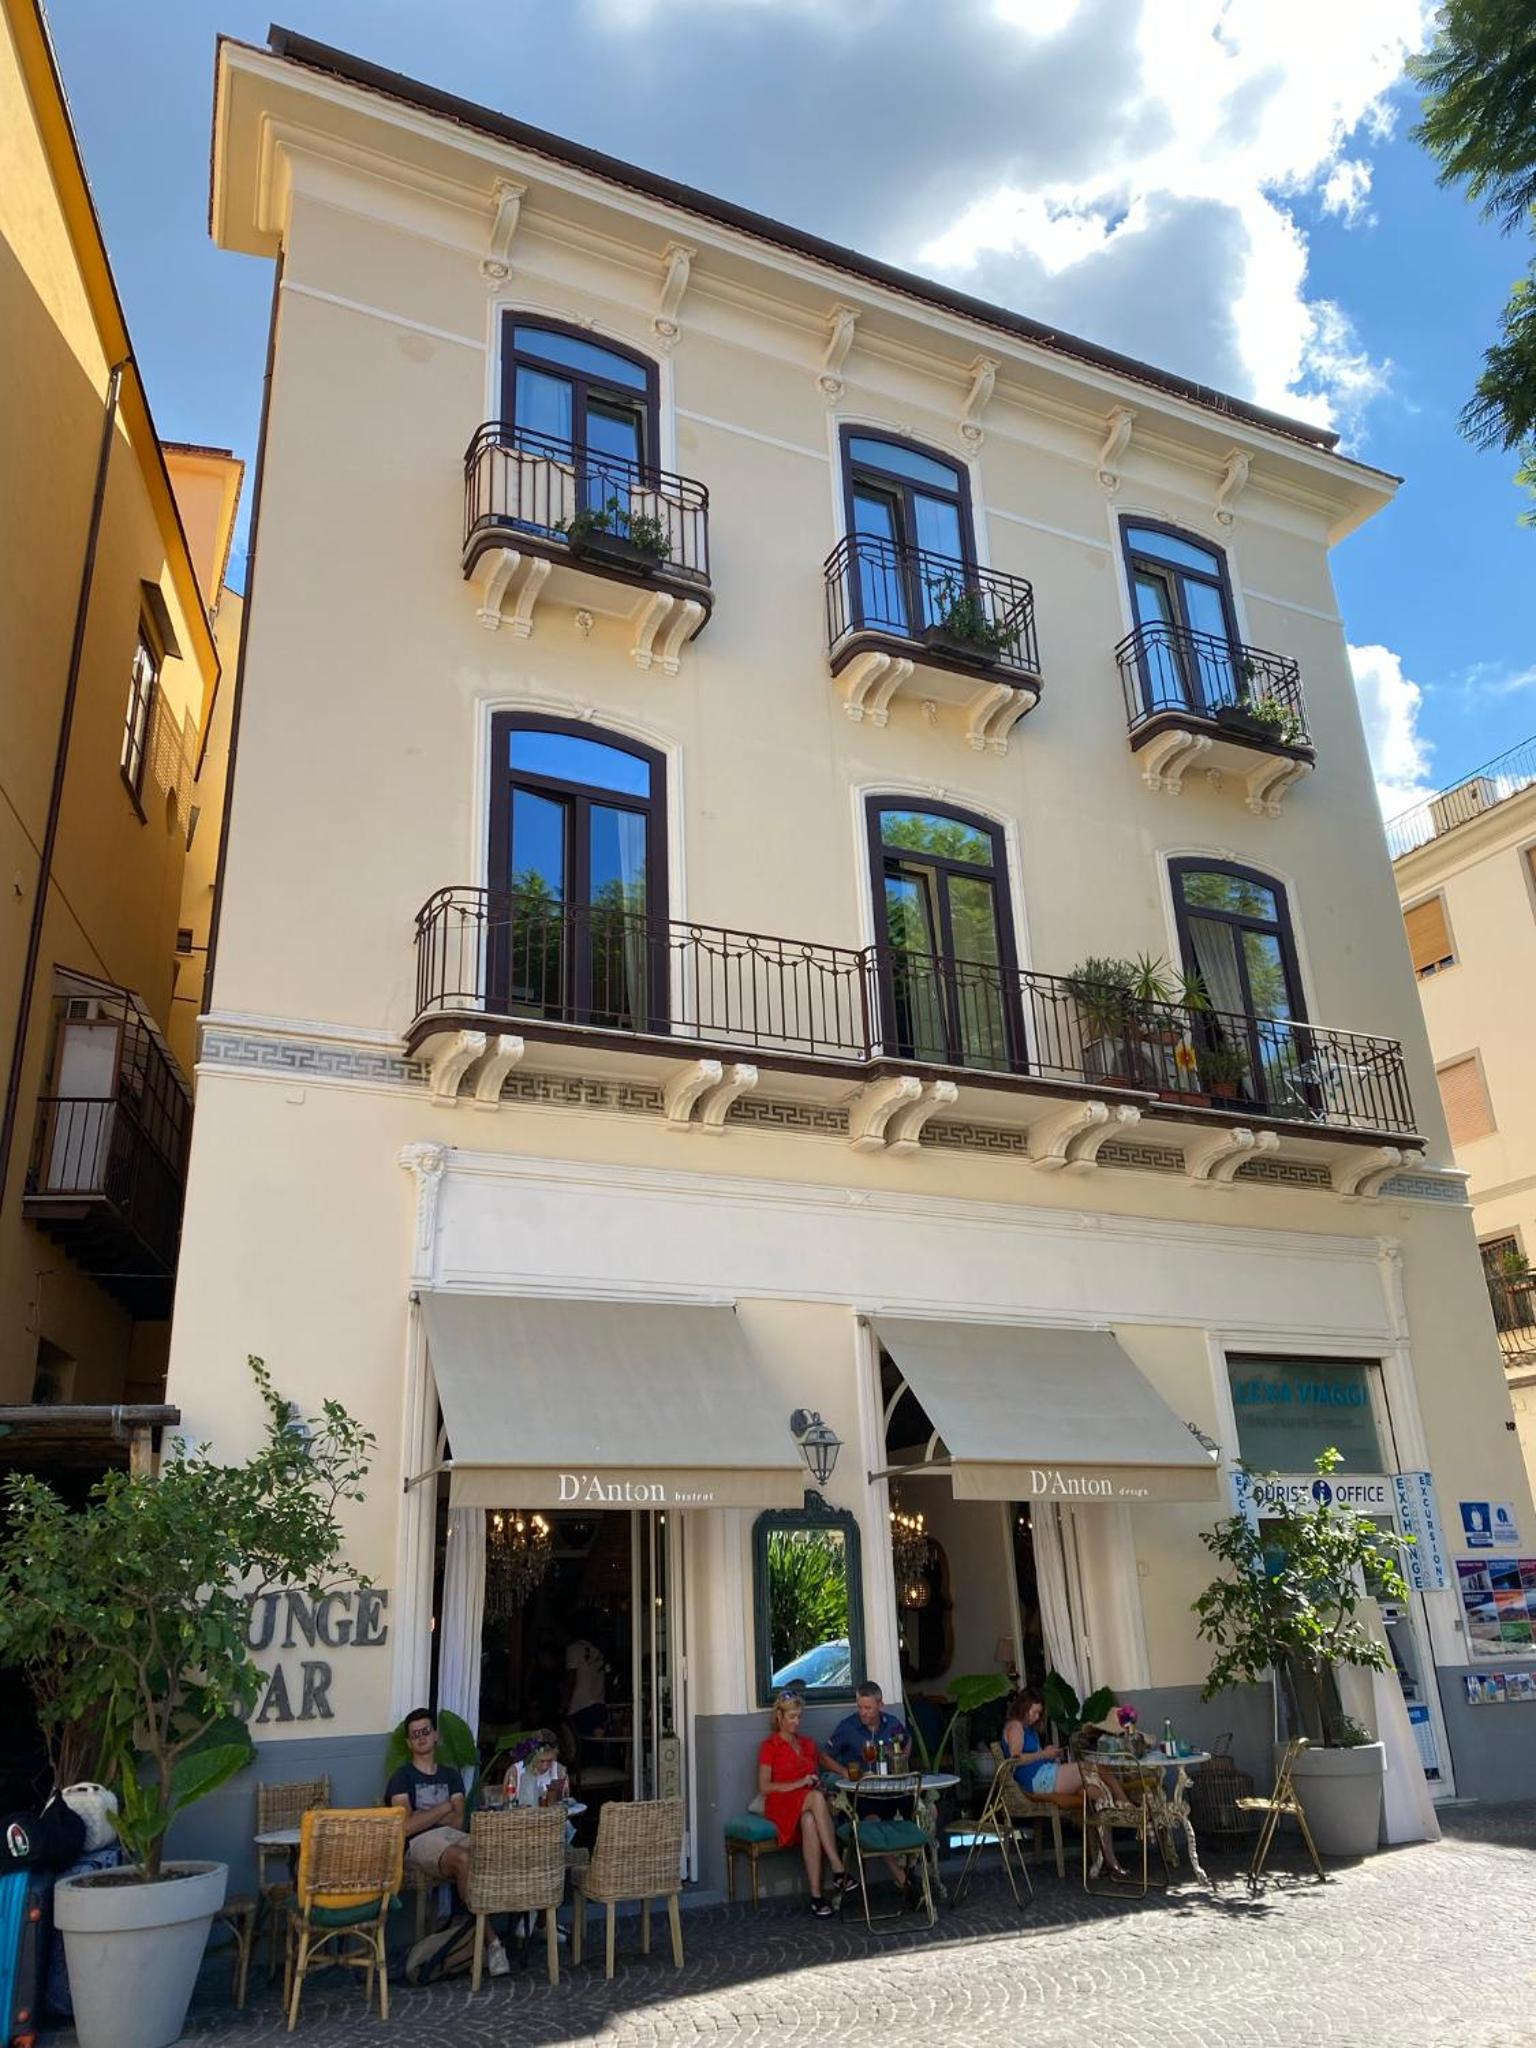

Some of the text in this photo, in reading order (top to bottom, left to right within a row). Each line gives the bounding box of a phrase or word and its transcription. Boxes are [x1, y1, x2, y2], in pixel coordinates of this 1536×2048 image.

[558, 1474, 666, 1501] D'Anton
[1030, 1470, 1113, 1495] D'Anton
[1254, 1486, 1309, 1502] OURIST
[1336, 1486, 1384, 1502] OFFICE
[1396, 1478, 1423, 1589] EXCHNGE
[244, 1589, 389, 1650] UNGE
